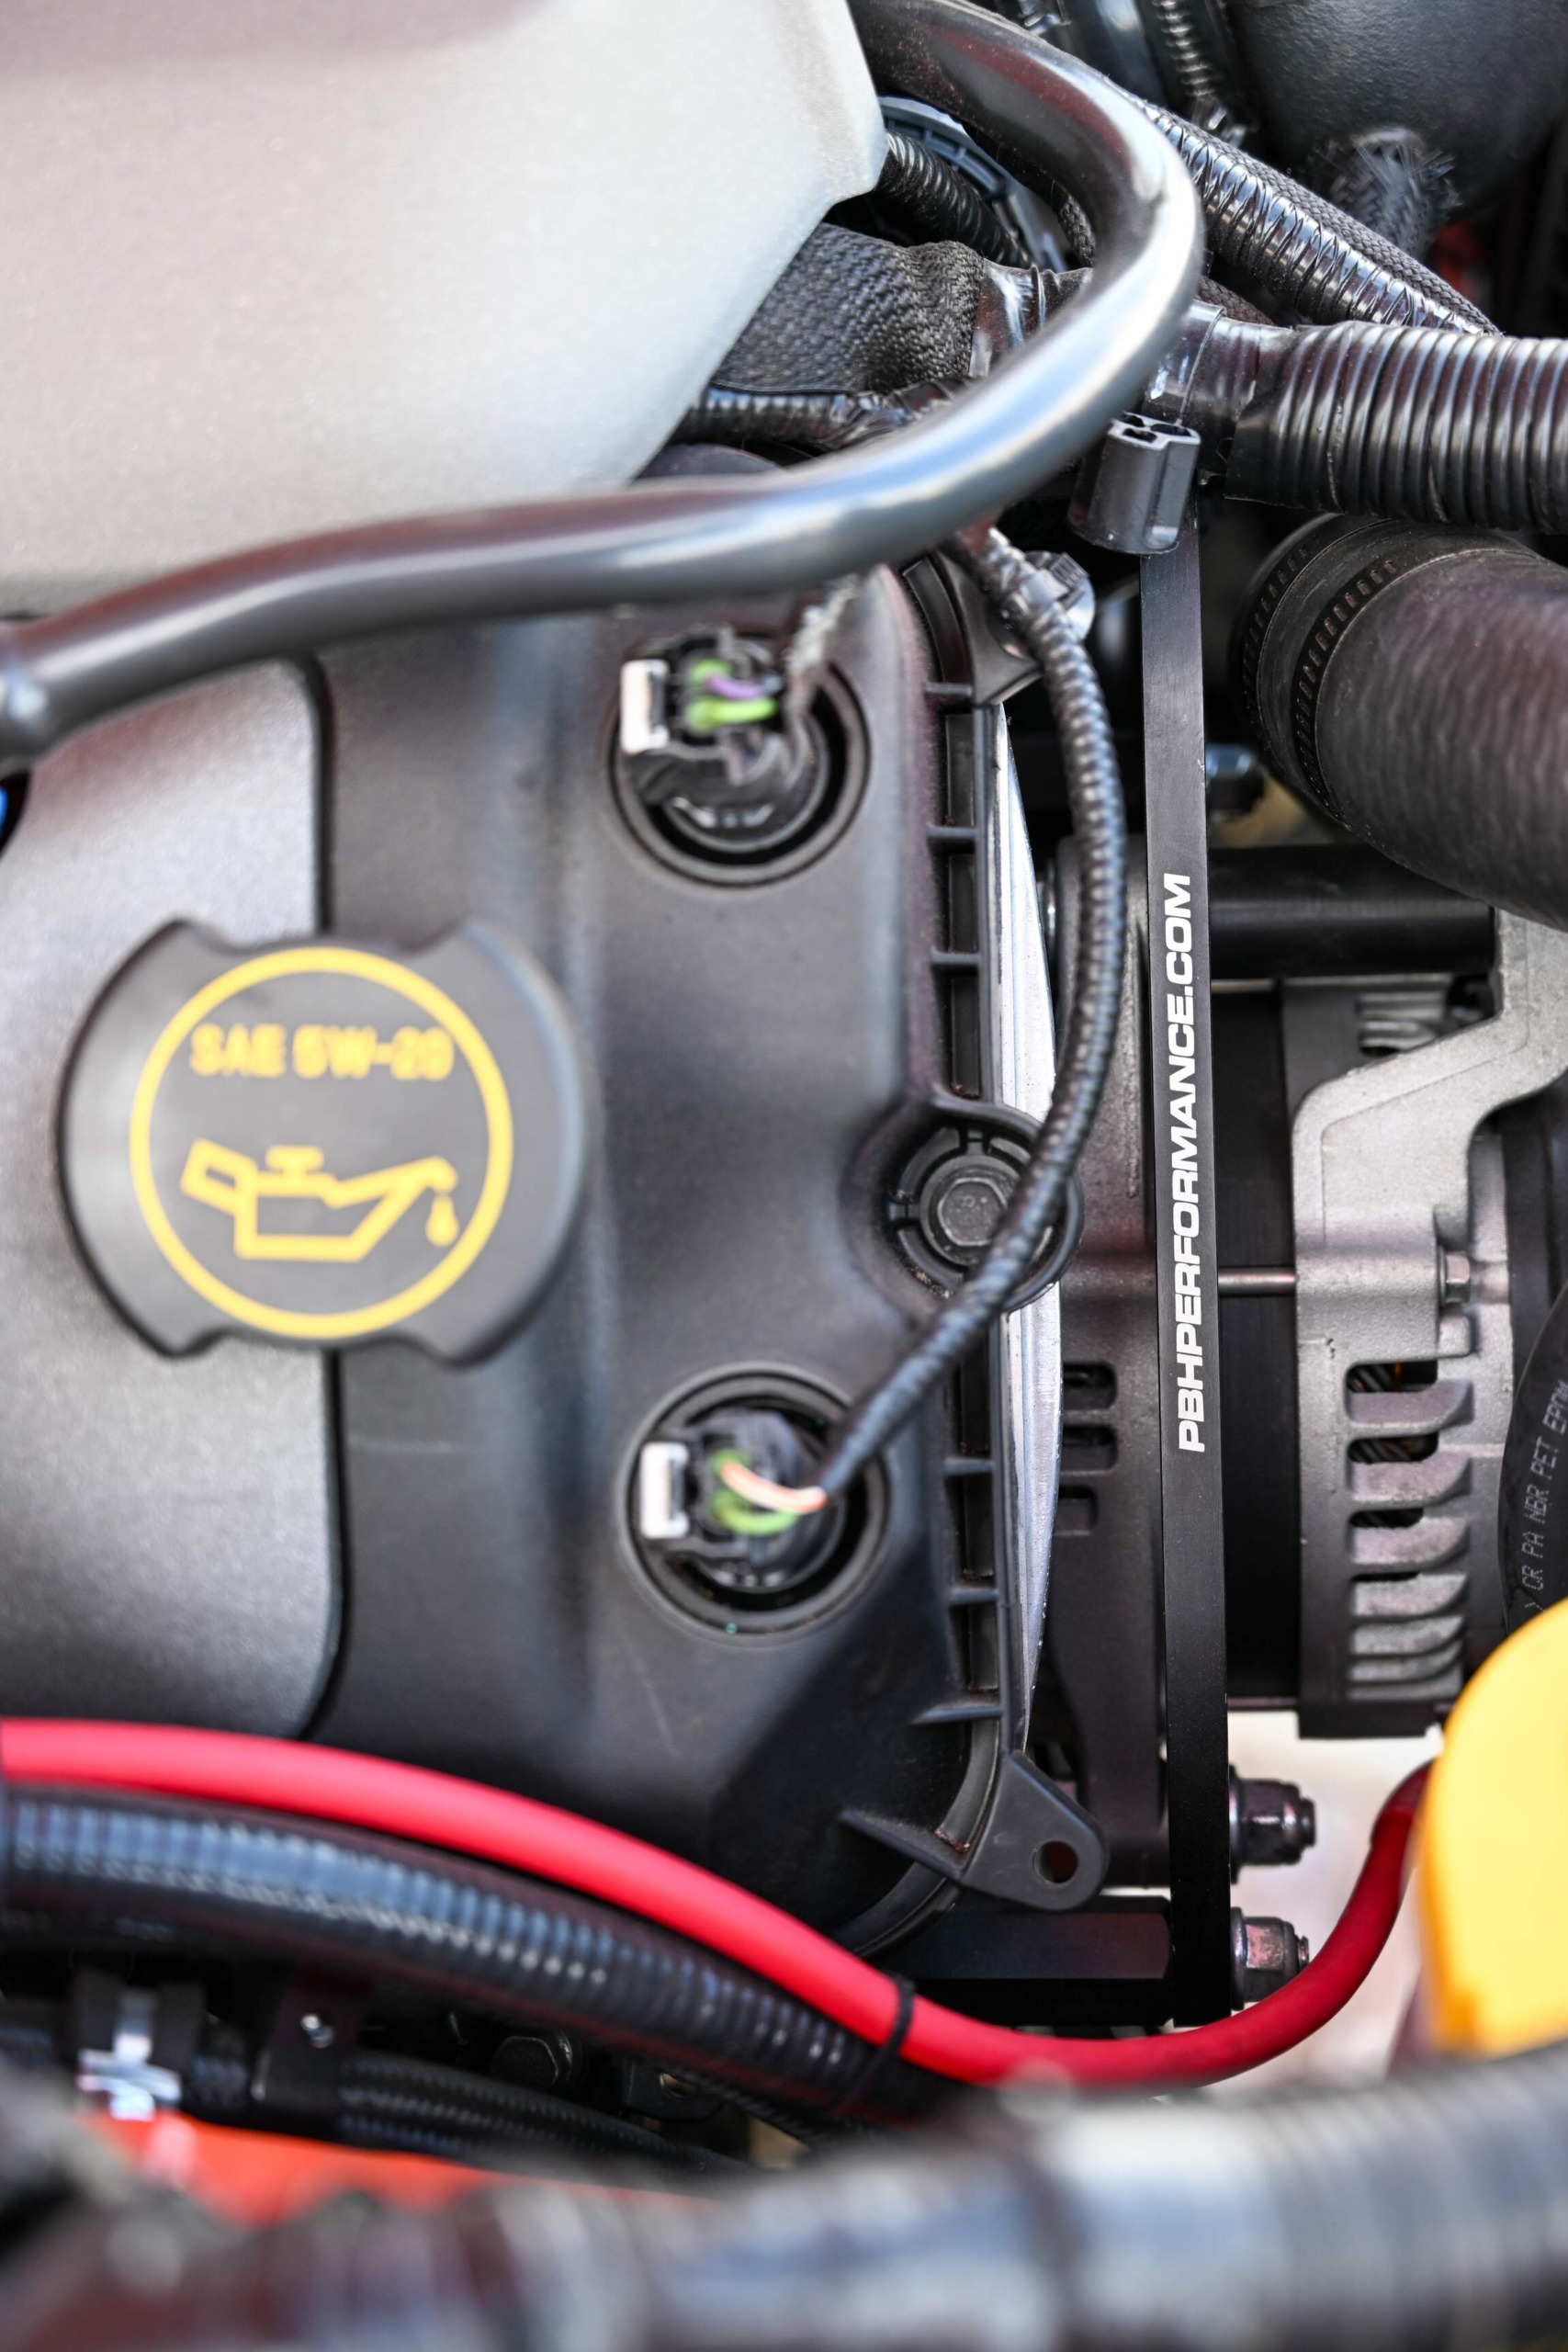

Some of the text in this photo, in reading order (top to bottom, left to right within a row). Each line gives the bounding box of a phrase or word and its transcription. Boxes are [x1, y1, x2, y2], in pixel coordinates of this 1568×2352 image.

[190, 1023, 287, 1078] SAE
[1163, 872, 1206, 1453] PBHPERFORMANCE.COM
[1529, 1435, 1559, 1480] PET
[1521, 1531, 1544, 1558] PA
[1521, 1565, 1544, 1590] CR
